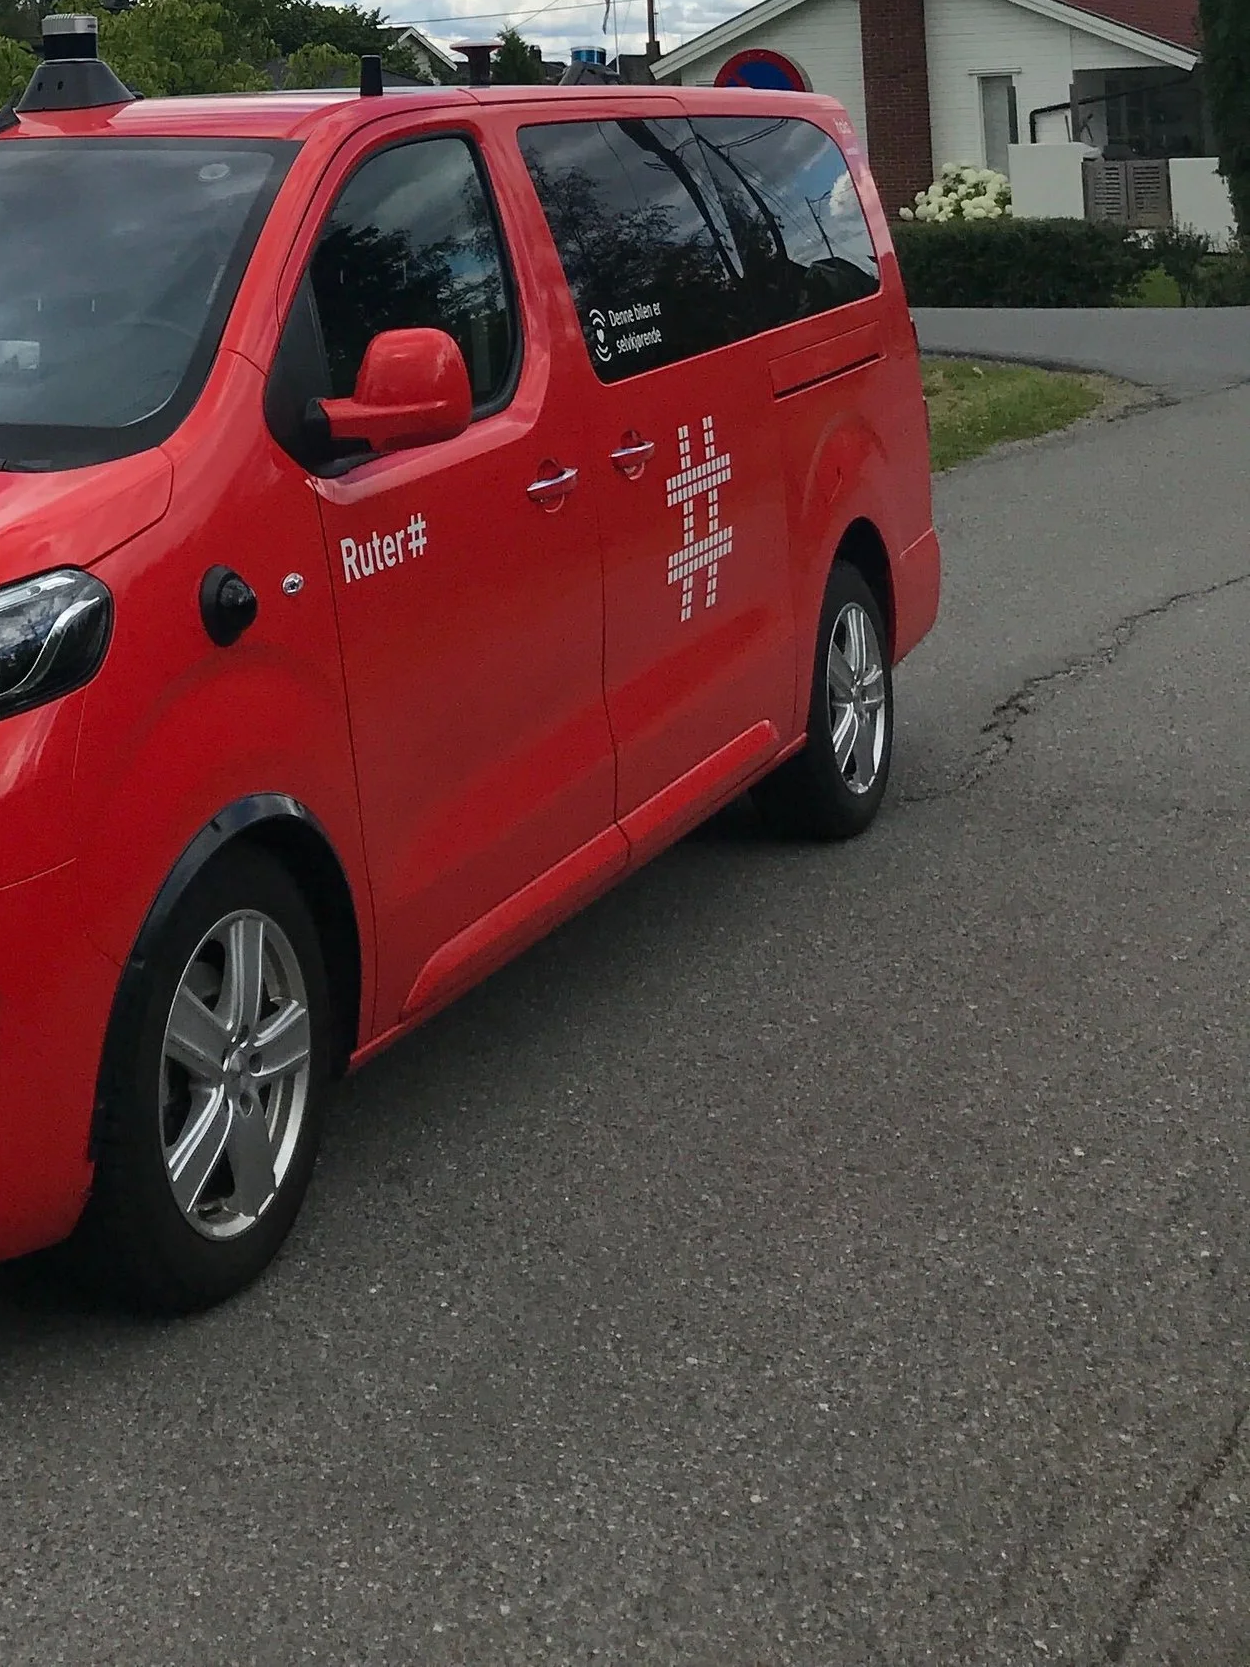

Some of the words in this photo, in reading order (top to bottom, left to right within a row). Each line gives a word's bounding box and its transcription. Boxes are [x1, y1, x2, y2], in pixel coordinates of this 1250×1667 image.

[608, 308, 635, 327] Denne
[633, 303, 652, 320] bilen
[652, 301, 662, 316] er
[616, 327, 662, 354] selvkjørende
[340, 512, 427, 584] Ruter#
